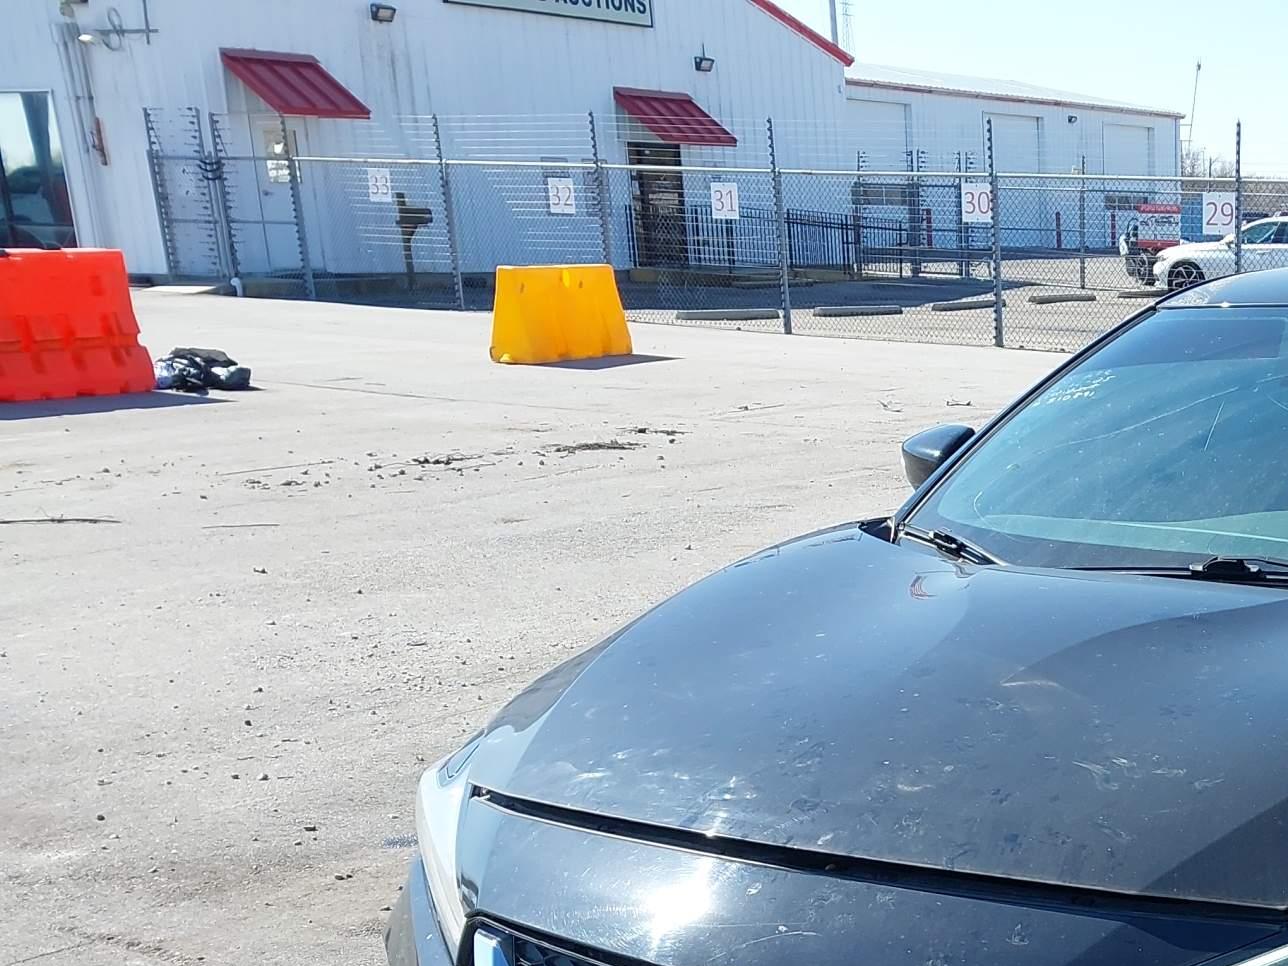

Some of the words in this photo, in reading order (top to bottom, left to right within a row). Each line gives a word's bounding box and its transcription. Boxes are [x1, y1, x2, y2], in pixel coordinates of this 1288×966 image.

[369, 174, 389, 195] 33
[550, 184, 573, 206] 32
[713, 189, 737, 212] 31
[964, 191, 990, 215] 30
[1205, 201, 1234, 226] 29
